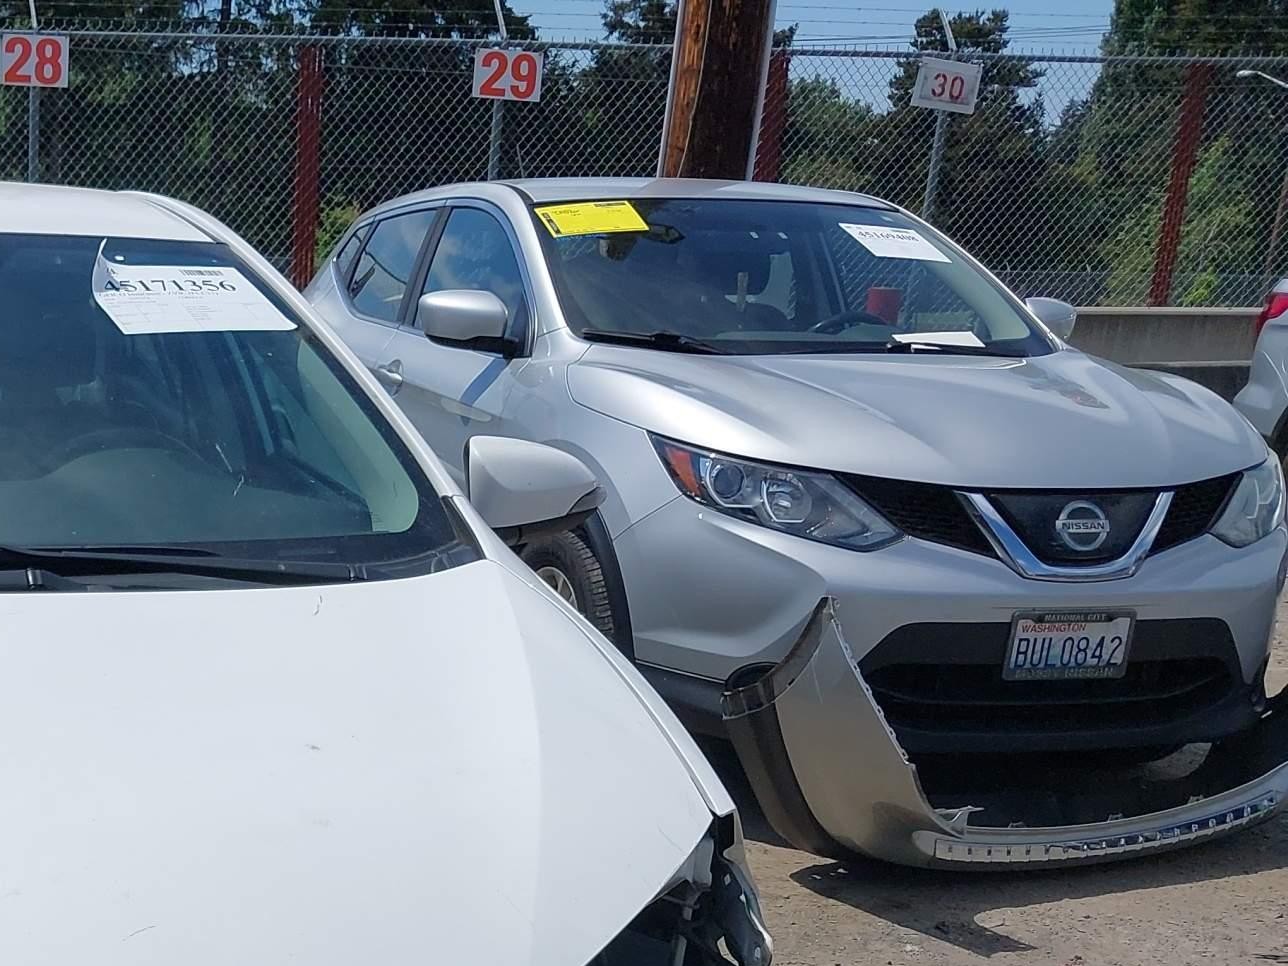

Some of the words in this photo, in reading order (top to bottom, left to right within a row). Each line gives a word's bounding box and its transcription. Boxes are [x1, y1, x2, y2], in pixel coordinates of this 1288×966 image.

[4, 36, 62, 85] 28
[479, 50, 538, 100] 29
[930, 72, 965, 101] 30
[103, 279, 237, 292] 45171356
[1061, 522, 1105, 531] NISSAN
[1021, 623, 1087, 633] WASHINGTON
[1044, 614, 1084, 622] NATIONAL
[1014, 636, 1123, 668] BUL0842
